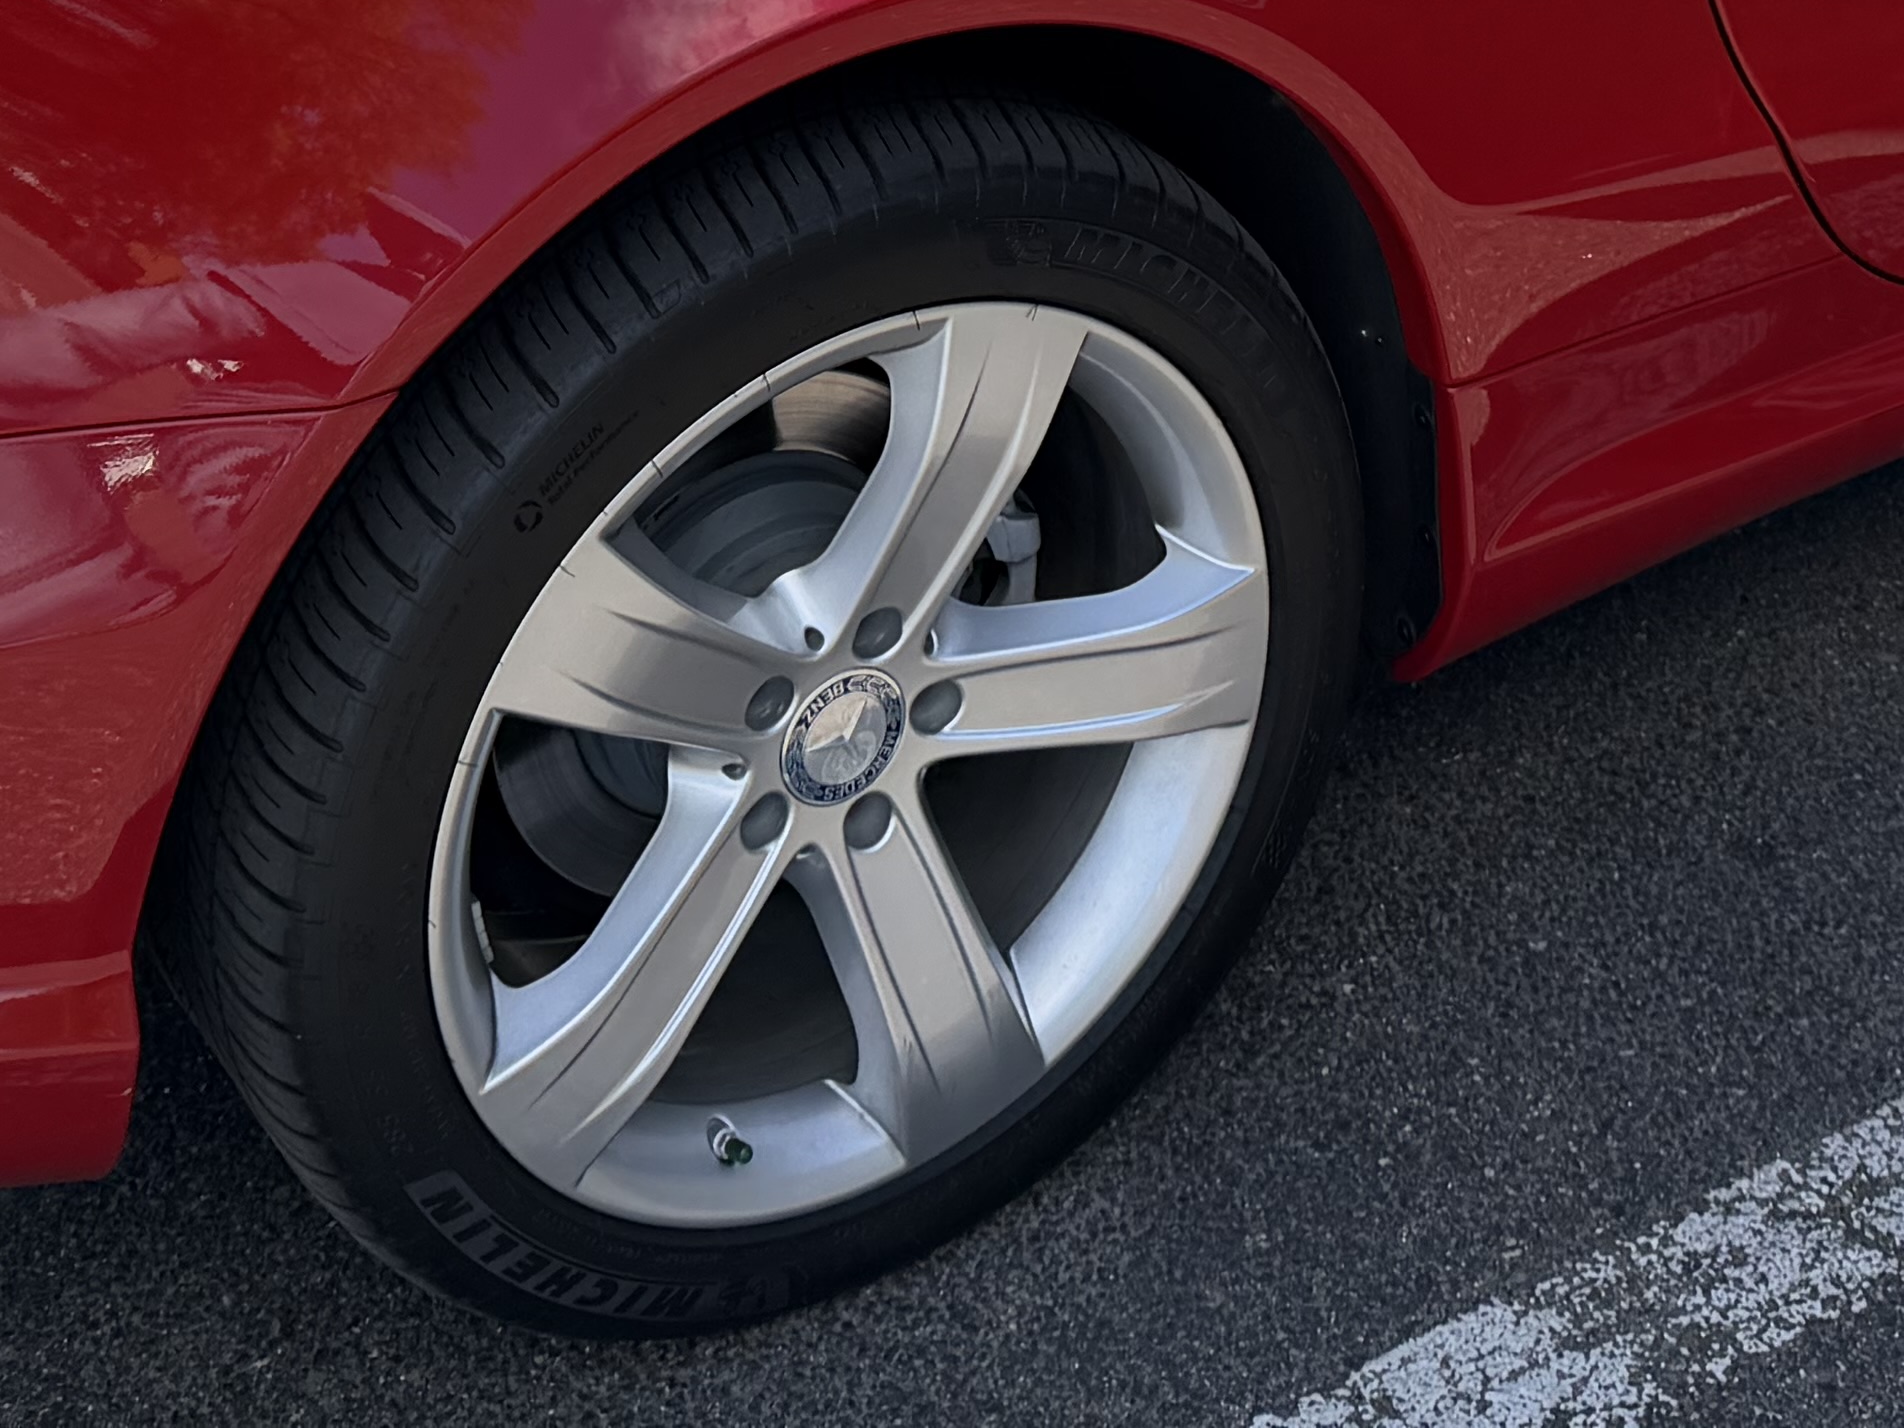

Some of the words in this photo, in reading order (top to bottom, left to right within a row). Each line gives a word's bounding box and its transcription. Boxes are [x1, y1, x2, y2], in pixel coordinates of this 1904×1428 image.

[537, 420, 606, 497] MICHELIN
[803, 680, 845, 725] BENZ
[823, 730, 900, 801] MERCEDES
[418, 1185, 705, 1320] MICHELIN
